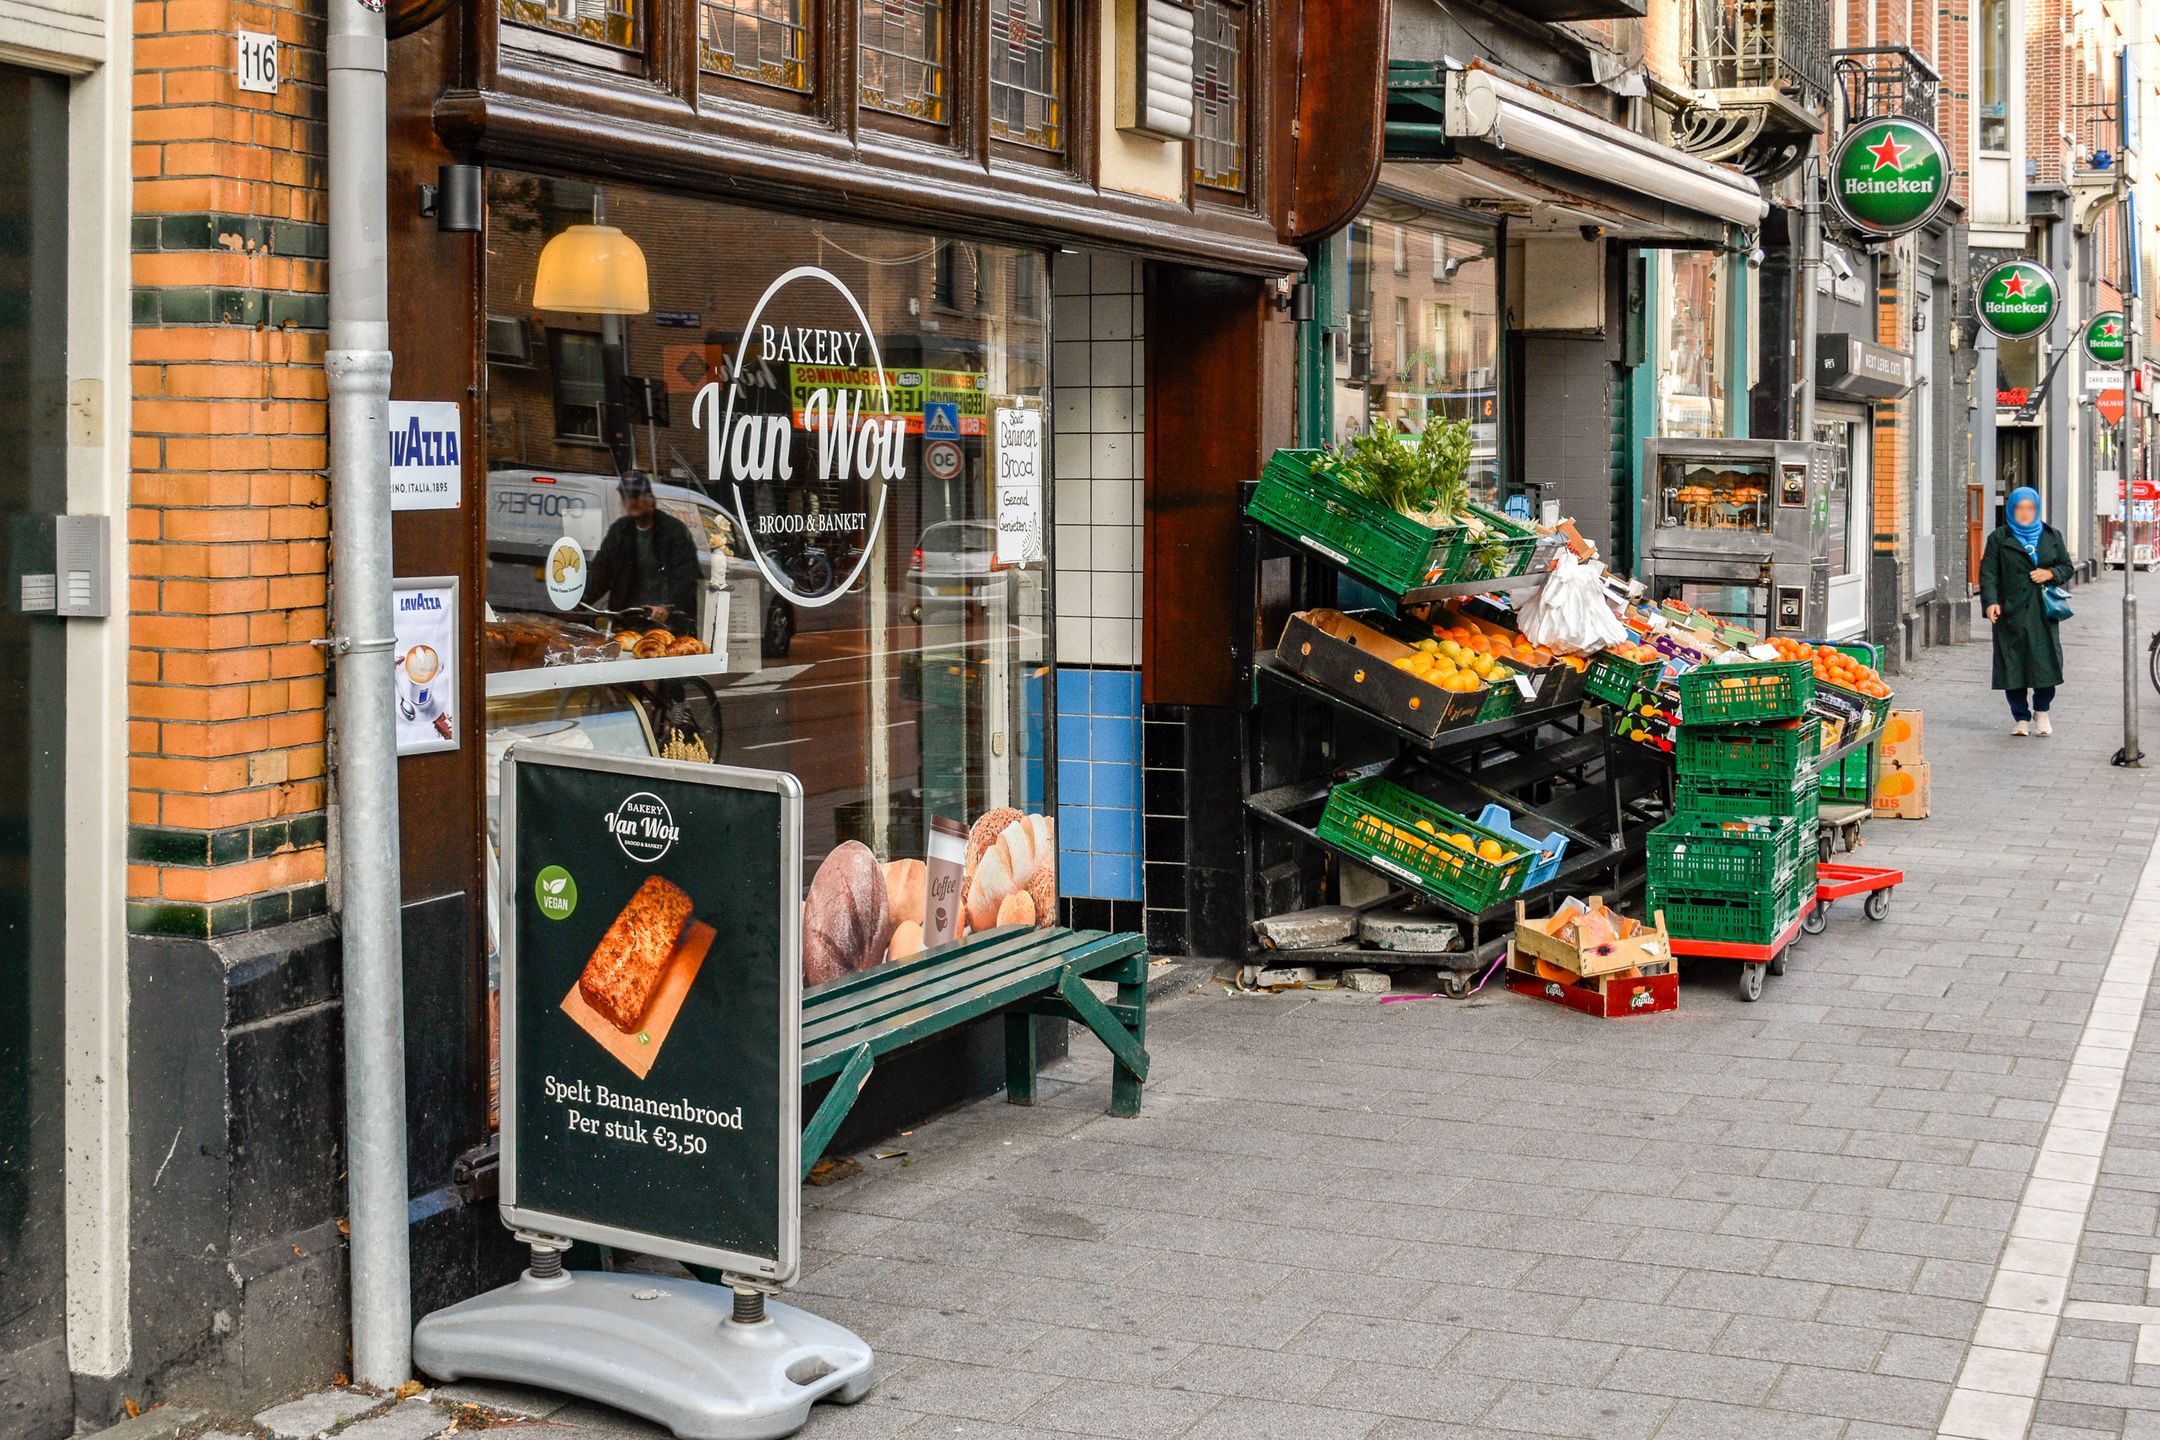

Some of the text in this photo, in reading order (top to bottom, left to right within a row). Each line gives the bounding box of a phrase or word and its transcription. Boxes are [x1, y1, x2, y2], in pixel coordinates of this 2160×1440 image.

[242, 42, 275, 82] 116
[1845, 176, 1934, 194] Heineken
[1985, 301, 2047, 313] Heineken
[761, 324, 861, 366] BAKERY
[2089, 339, 2124, 348] Heinek
[1865, 353, 1876, 369] NEXT
[1877, 356, 1889, 374] LEVEL
[389, 416, 459, 466] VAZZA
[692, 382, 906, 480] Van Wou
[1001, 421, 1038, 448] Bananen
[1001, 452, 1034, 479] Brood
[1003, 490, 1029, 507] Gezond
[759, 513, 867, 534] BROOD & BANKET
[999, 512, 1029, 532] Genieten
[400, 593, 442, 611] LAVAZZA
[627, 802, 664, 815] BAKERY
[604, 812, 680, 841] Van Wou
[931, 875, 957, 902] Coffee
[543, 895, 568, 911] VEGAN
[545, 1075, 744, 1130] Spelt Bananenbrood
[568, 1109, 708, 1154] Per stuk €3,50
